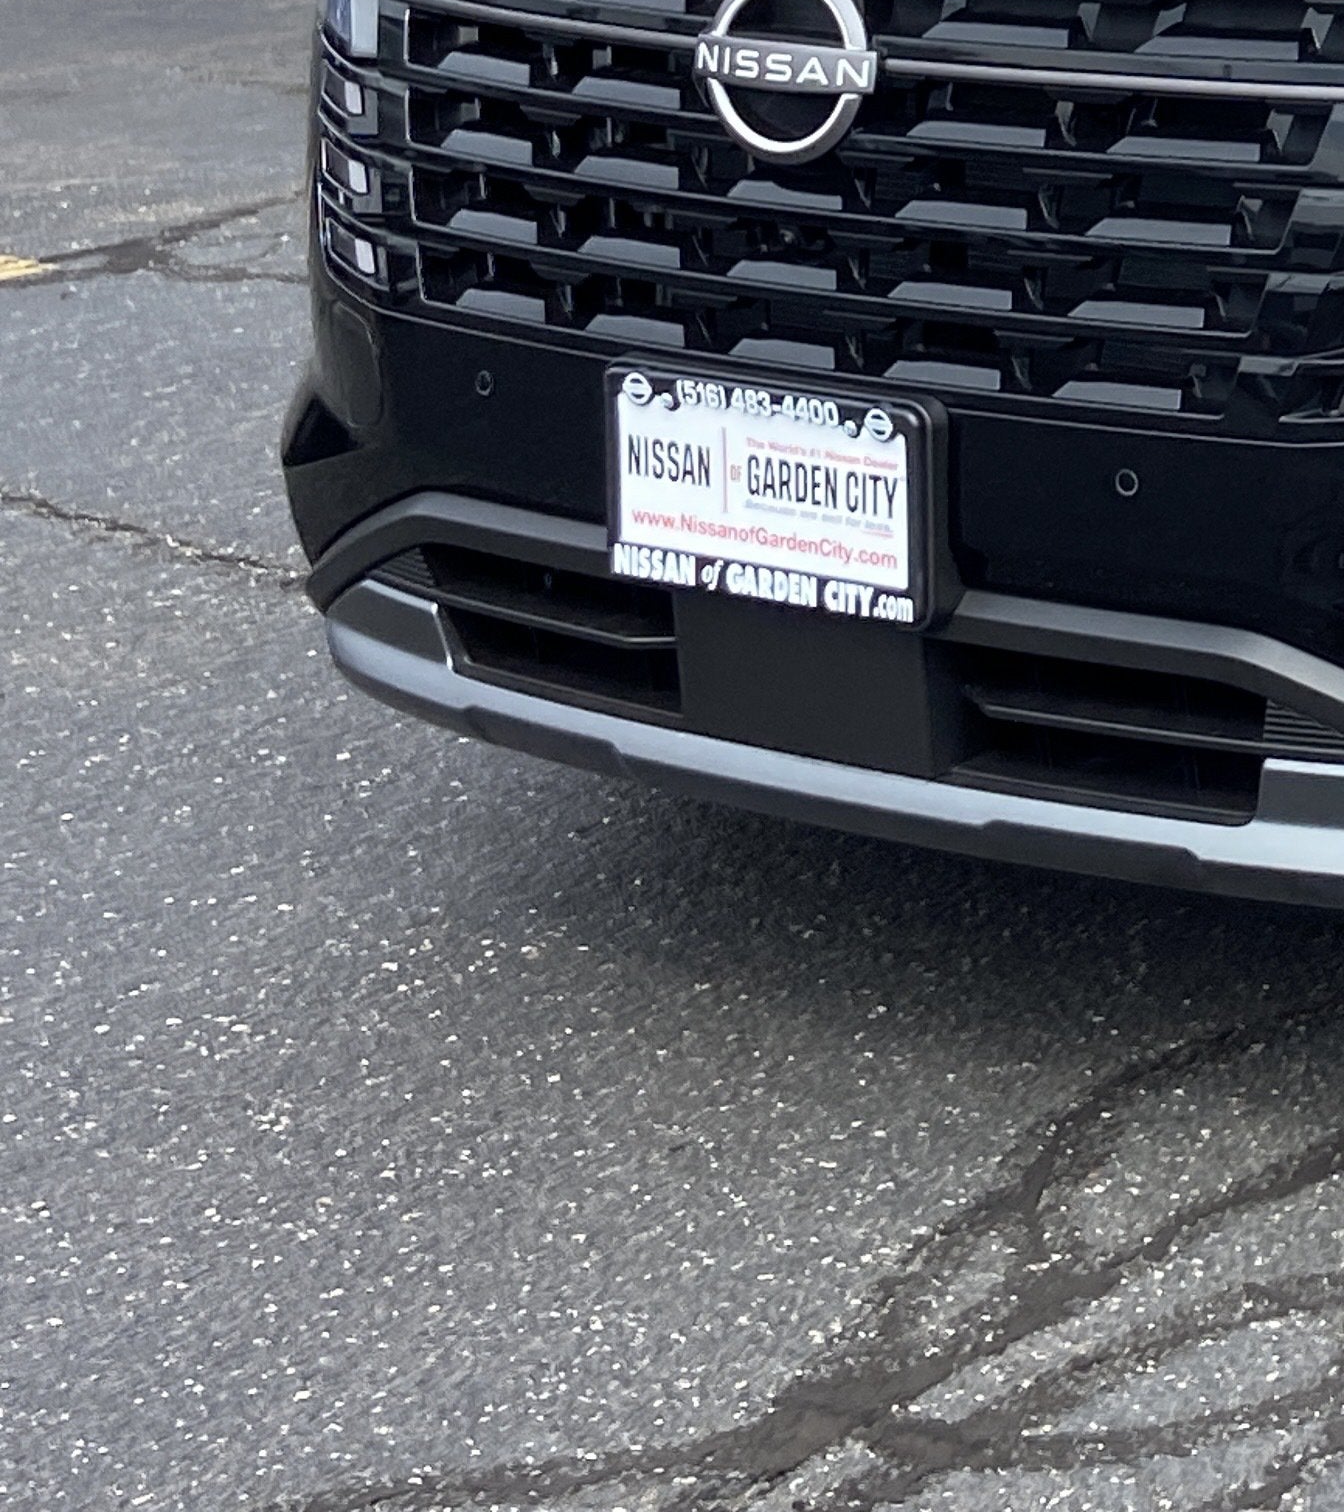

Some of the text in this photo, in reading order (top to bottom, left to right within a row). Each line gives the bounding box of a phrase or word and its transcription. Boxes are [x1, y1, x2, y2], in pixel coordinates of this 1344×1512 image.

[697, 41, 870, 88] NISSAN
[676, 379, 839, 427] (516) 483-4400
[628, 434, 898, 519] NISSAN OF GARDEN CITY
[632, 509, 898, 569] www.NissanofGardenCity.com
[614, 543, 914, 623] NISSAN of GARDEN CITY.com
